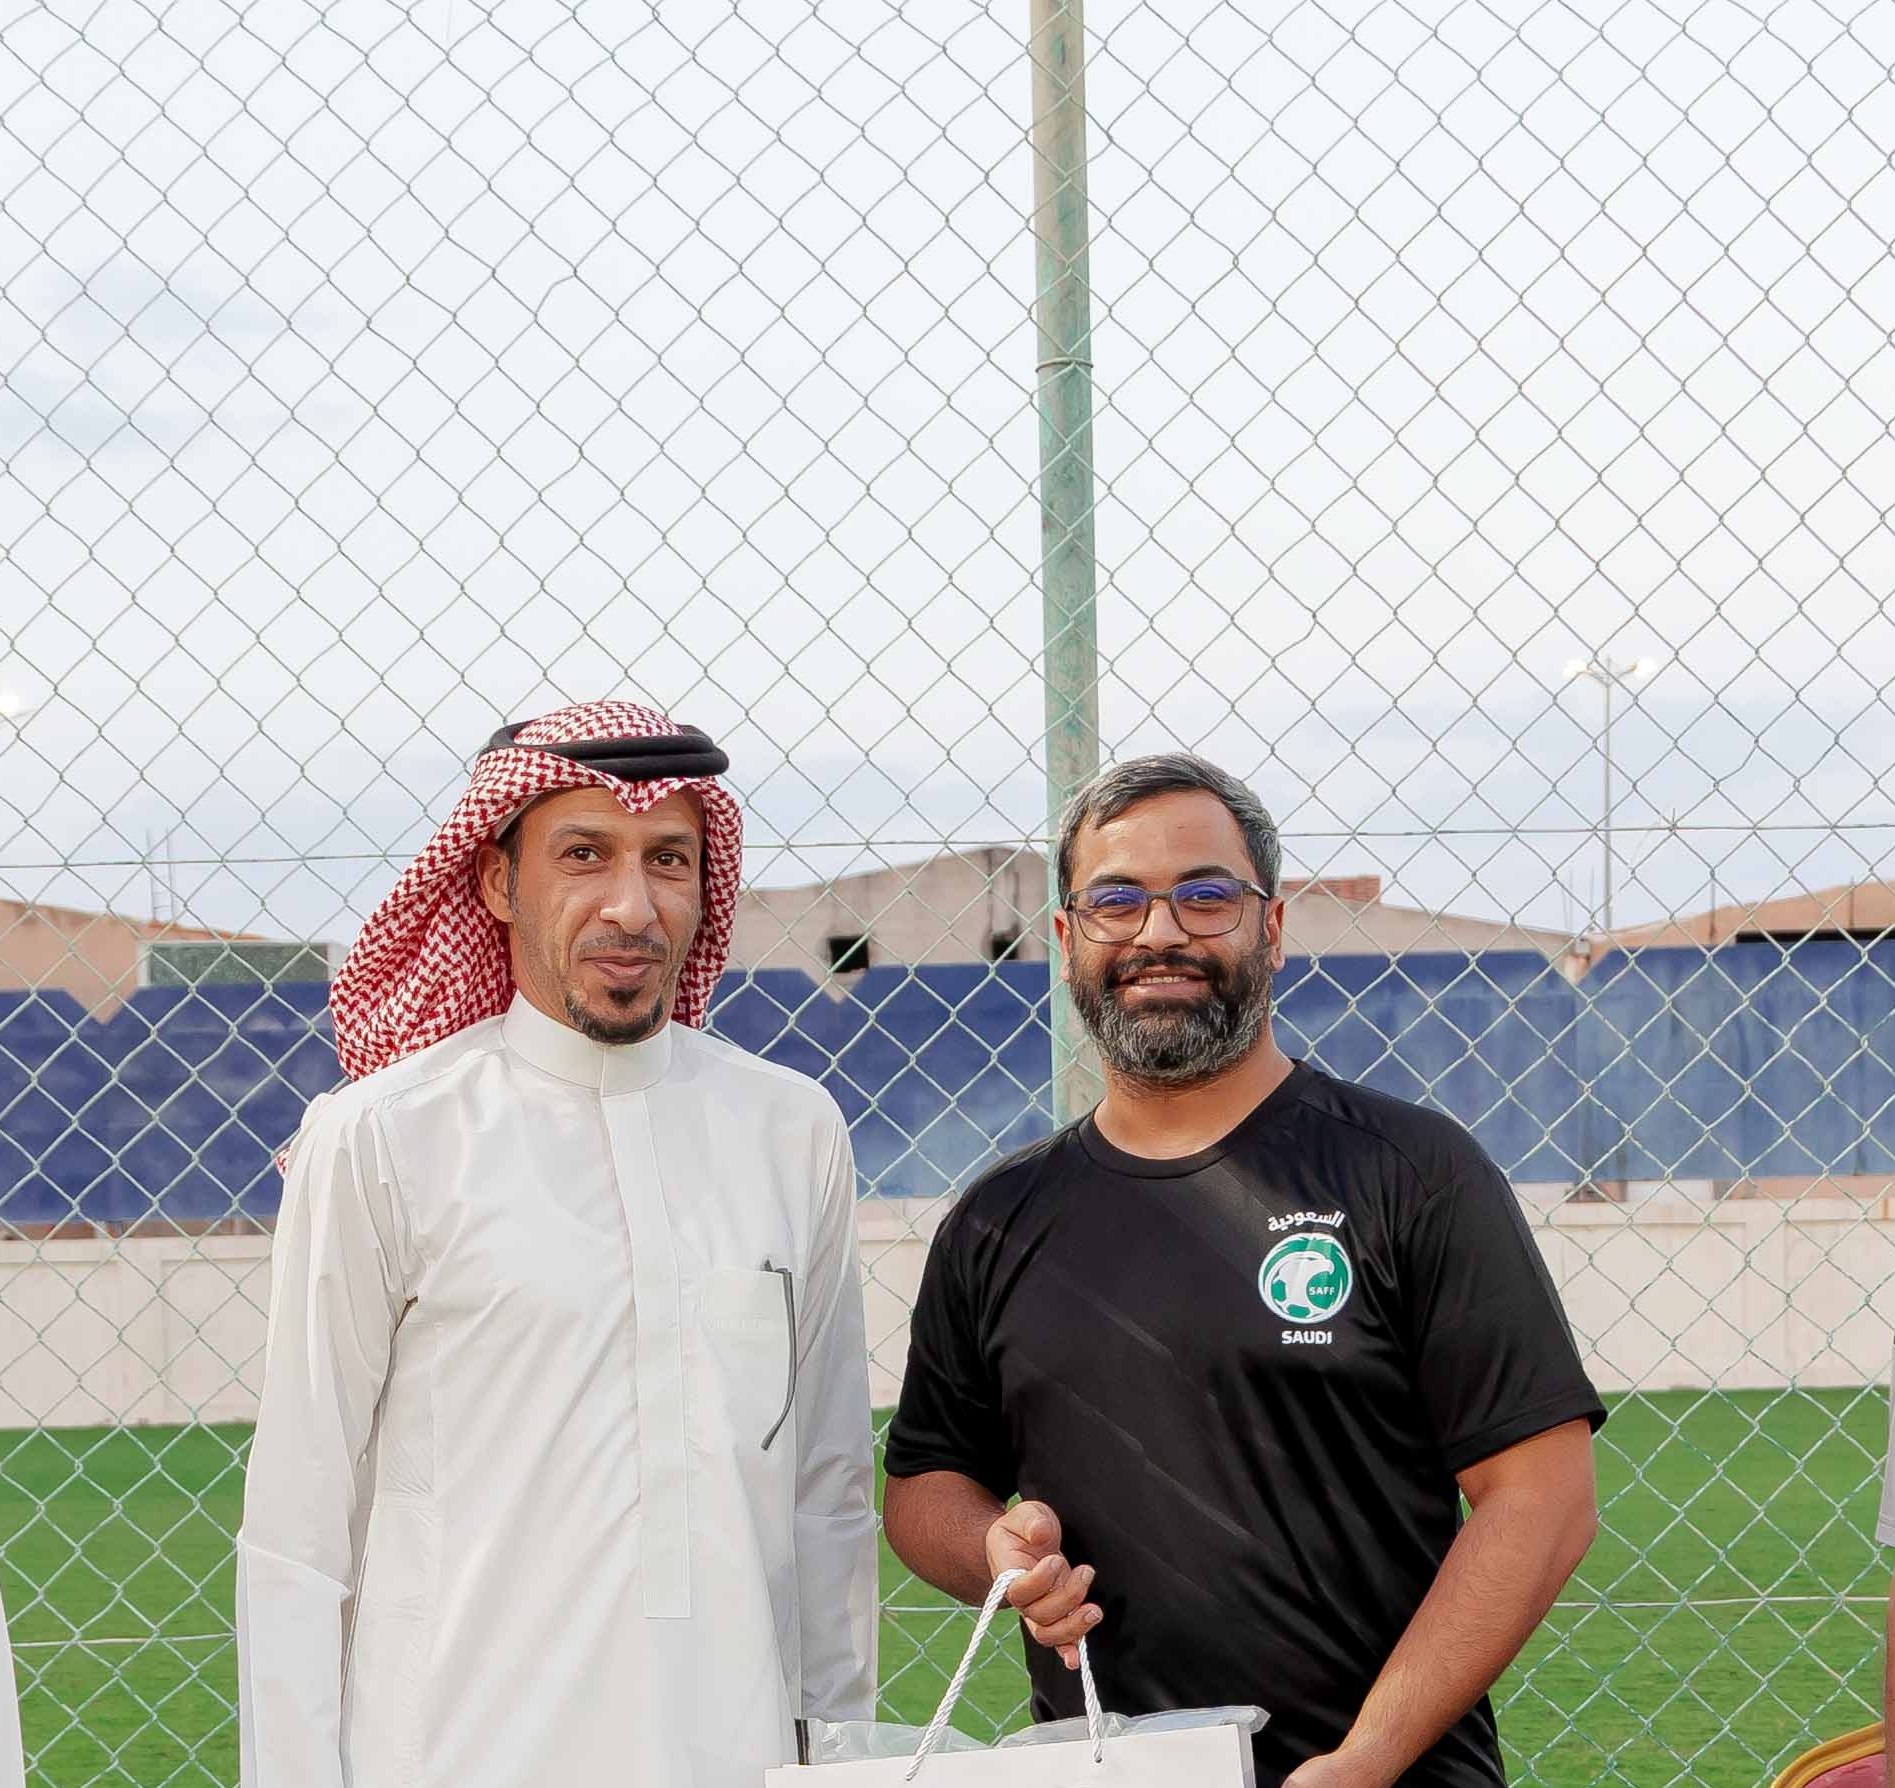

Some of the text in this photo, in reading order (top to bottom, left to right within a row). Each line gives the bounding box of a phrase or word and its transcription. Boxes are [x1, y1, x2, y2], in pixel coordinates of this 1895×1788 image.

[1267, 1210, 1346, 1232] السعودية
[1308, 1286, 1335, 1296] SAFF
[1281, 1330, 1333, 1345] SAUDI
